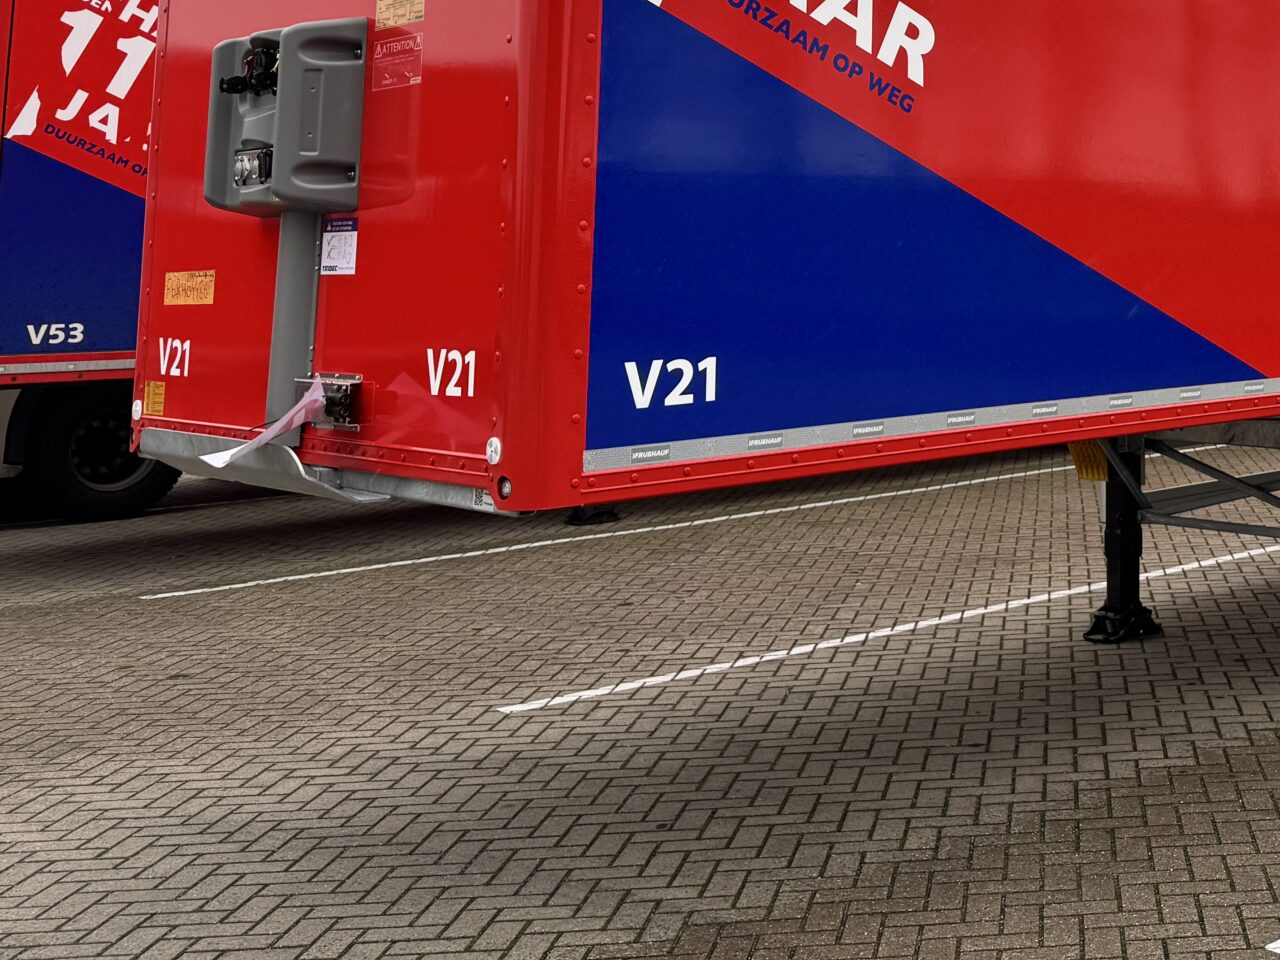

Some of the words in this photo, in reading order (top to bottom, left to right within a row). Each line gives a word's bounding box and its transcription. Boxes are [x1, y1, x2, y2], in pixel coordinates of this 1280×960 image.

[382, 38, 415, 54] ATTENTION
[832, 53, 863, 80] OP
[868, 71, 915, 114] WEG
[43, 123, 130, 168] DUURZAAM
[27, 322, 84, 345] V53
[159, 337, 191, 377] V21
[426, 348, 476, 398] V21
[624, 356, 717, 409] V21
[633, 449, 670, 459] FRUEHAUF
[749, 437, 782, 446] FRUEHAUF
